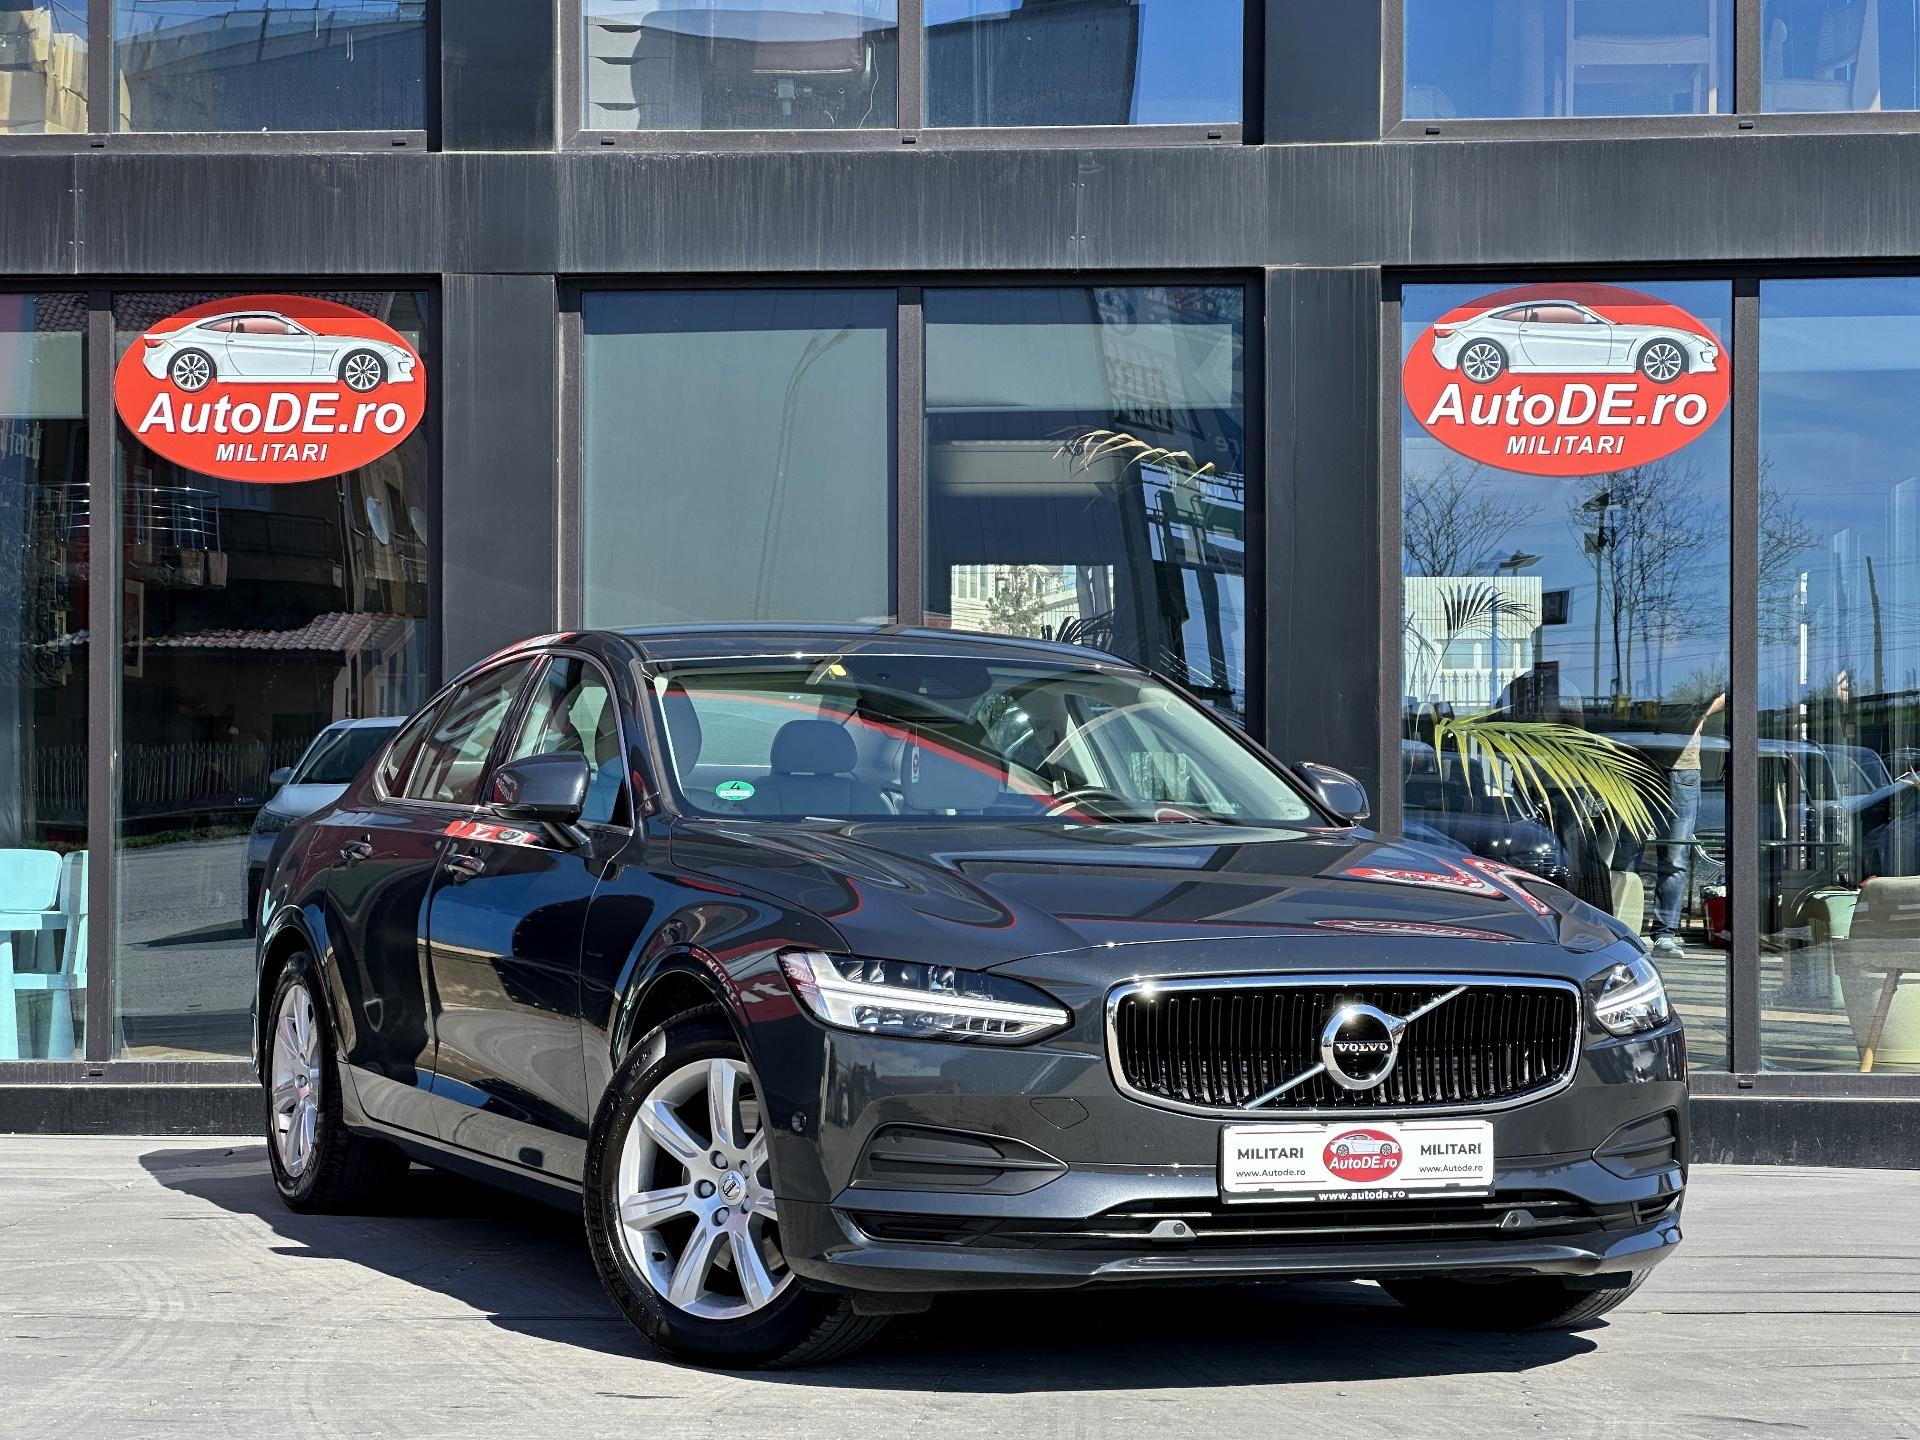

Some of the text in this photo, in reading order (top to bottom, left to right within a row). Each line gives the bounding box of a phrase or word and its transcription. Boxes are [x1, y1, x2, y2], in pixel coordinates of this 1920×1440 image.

[1425, 383, 1709, 427] AutoDE.ro
[137, 392, 407, 435] AutoDE.ro
[1506, 435, 1625, 455] MILITARI
[215, 443, 328, 462] MILITARI
[1335, 1042, 1389, 1053] VOLVO
[1237, 1147, 1304, 1160] MILITARI
[1420, 1142, 1482, 1156] MILITARI
[1328, 1155, 1398, 1170] AutoDE.ro
[1419, 1163, 1484, 1173] www.Autode.ro
[1235, 1168, 1306, 1178] www.Autode.ro
[1318, 1189, 1406, 1201] www.autode.ro
